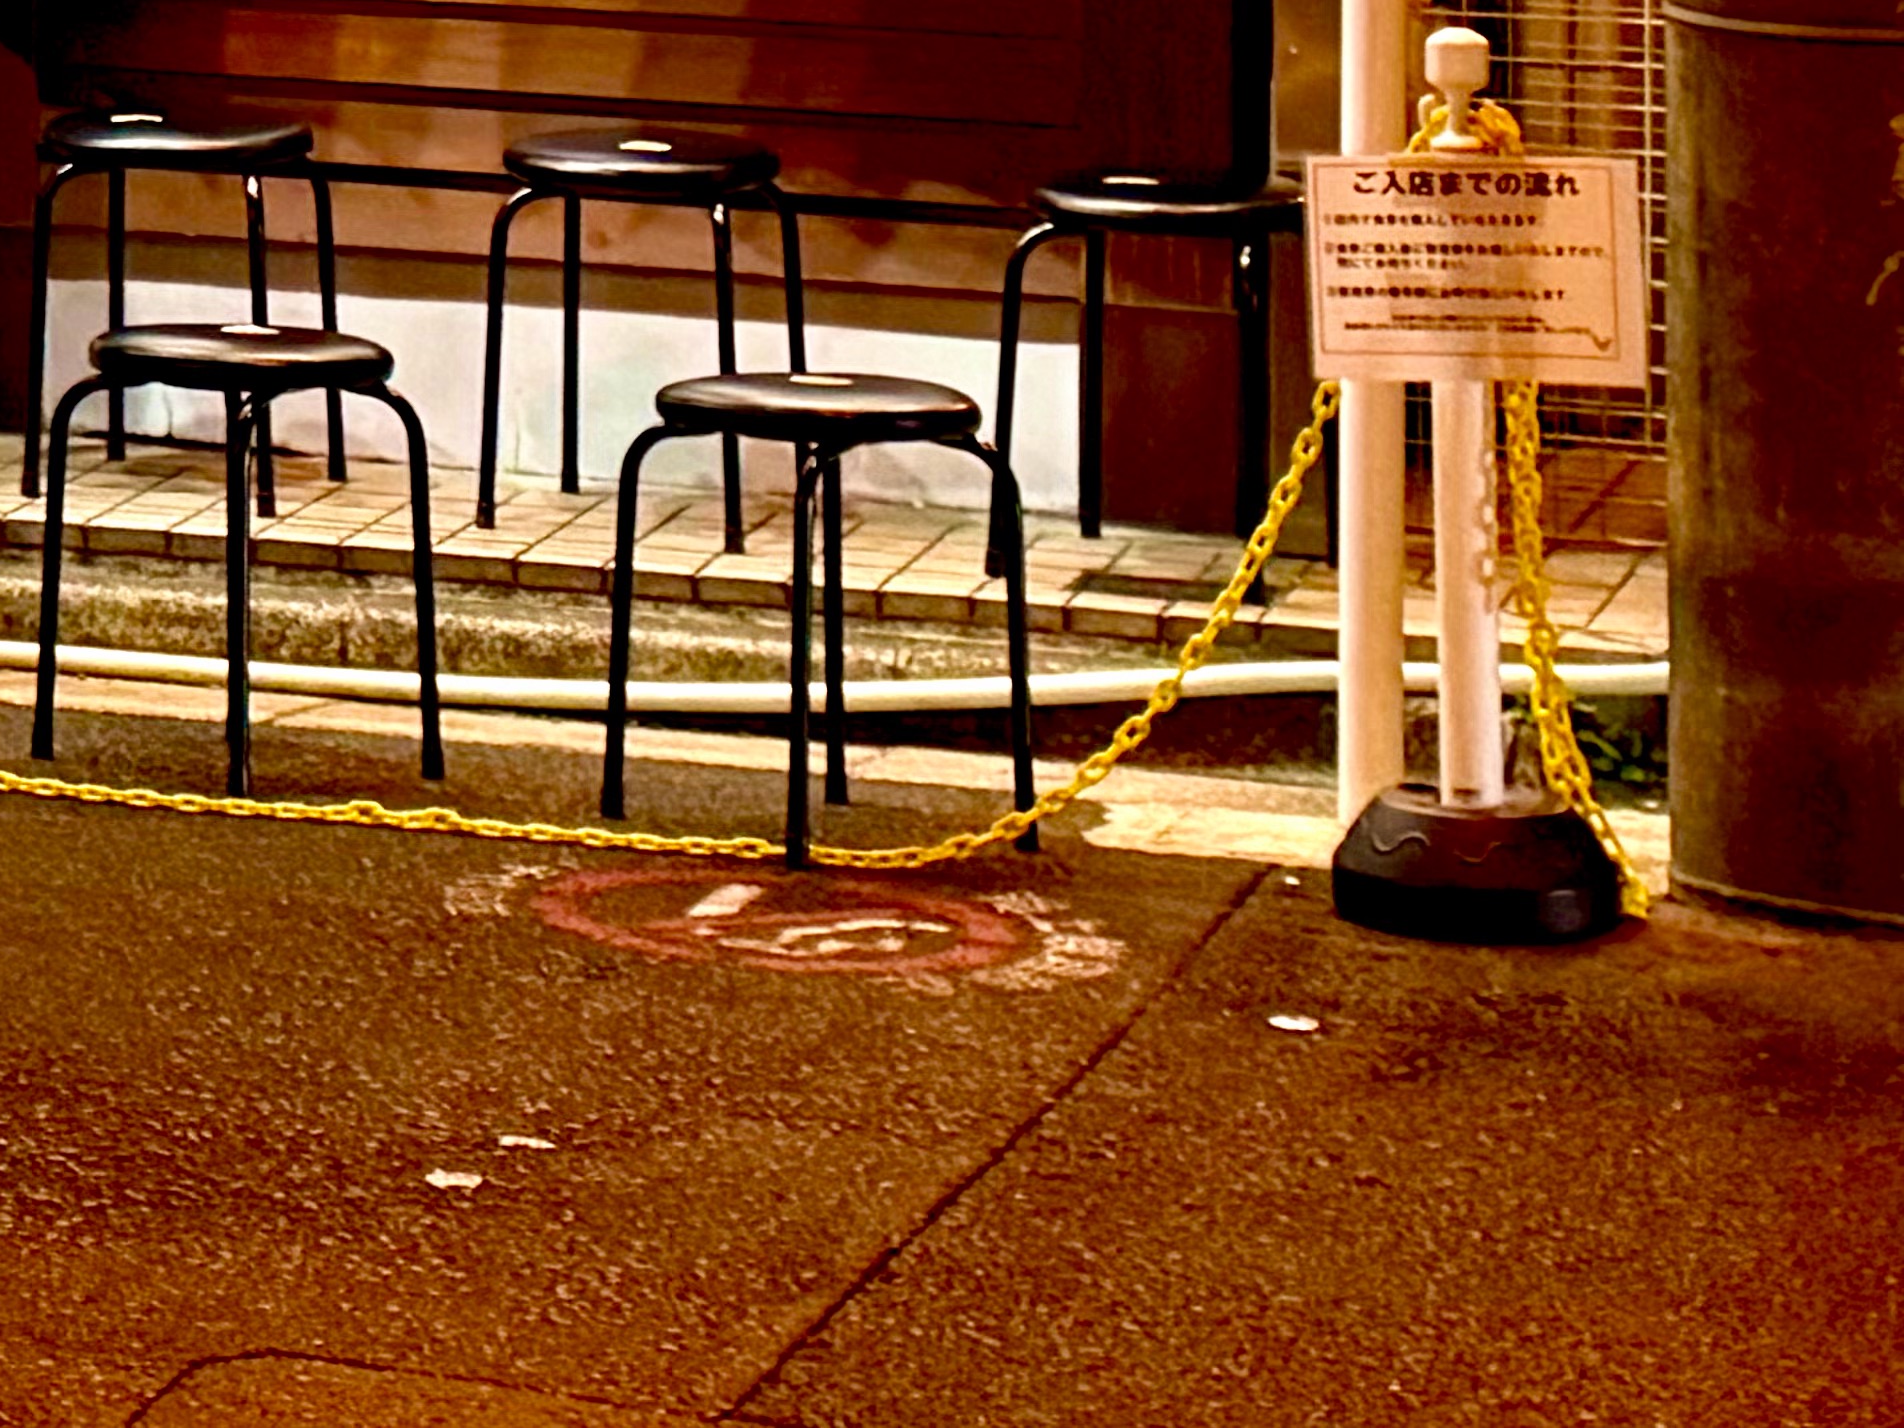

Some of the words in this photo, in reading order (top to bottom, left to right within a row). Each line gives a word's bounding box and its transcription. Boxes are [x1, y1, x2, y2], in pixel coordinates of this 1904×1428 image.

[1353, 170, 1580, 197] ご入店までの流れ
